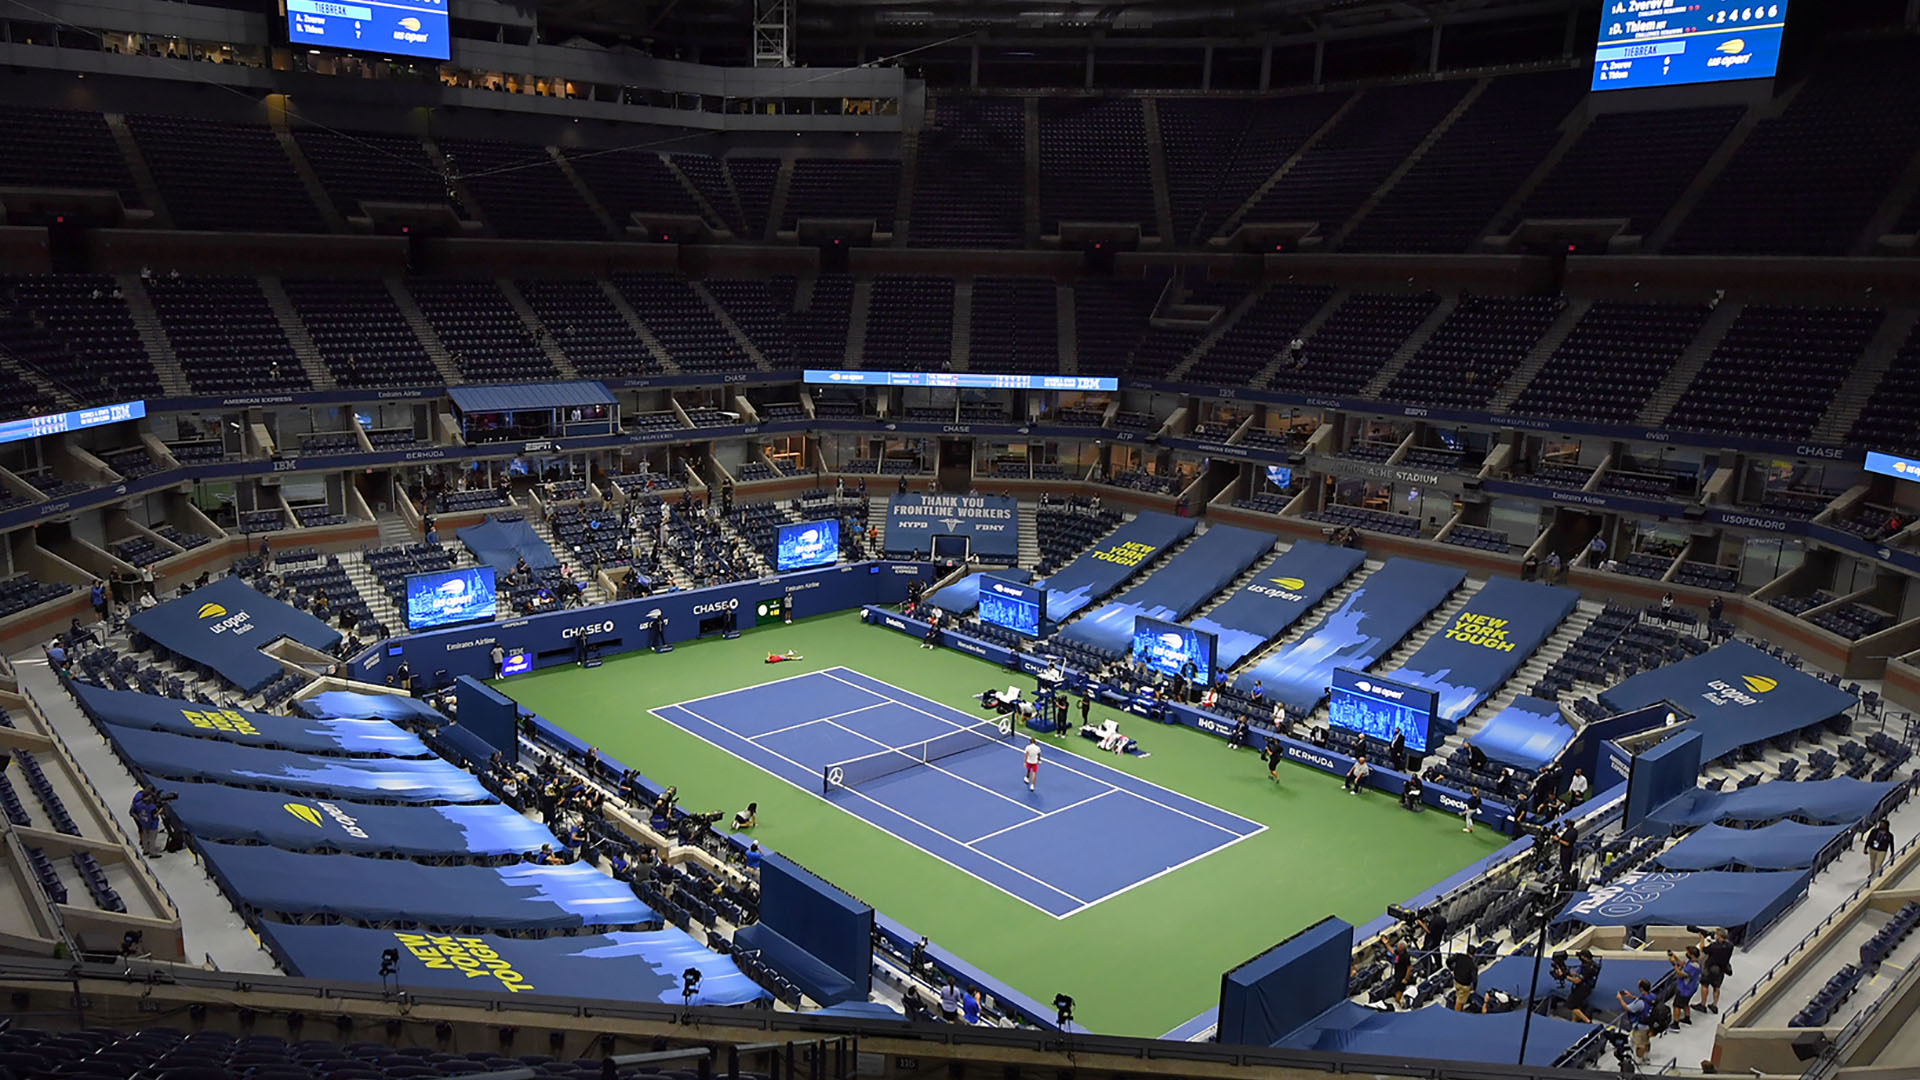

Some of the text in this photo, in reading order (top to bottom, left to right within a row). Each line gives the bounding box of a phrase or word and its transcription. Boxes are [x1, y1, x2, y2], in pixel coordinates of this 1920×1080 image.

[315, 2, 347, 15] TIEBREAK
[1626, 20, 1656, 33] Thiem
[1716, 10, 1726, 24] 2
[1729, 9, 1738, 21] 4
[1742, 8, 1751, 20] 6
[1755, 6, 1764, 19] 6
[1768, 4, 1777, 17] 6
[1624, 45, 1657, 57] TIEBREAK
[724, 374, 747, 383] CHASE
[223, 396, 293, 405] AMERICAN EXPRESS
[111, 404, 131, 421] IBM
[1404, 407, 1427, 417] ESPN
[943, 425, 970, 433] CHASE
[1645, 430, 1669, 441] evian
[1117, 432, 1133, 441] ATP
[525, 441, 551, 451] ESPN
[1796, 445, 1843, 459] CHASE
[406, 450, 444, 460] BERMUDA
[273, 459, 297, 471] IBM
[1396, 471, 1438, 485] STADIUM
[921, 495, 984, 508] THANK YOU
[1552, 491, 1606, 505] Emirates Airline
[893, 505, 1011, 519] FRONTLINE WORKERS
[898, 521, 1005, 532] NYPD FDNY
[1722, 513, 1786, 531] USOPEN.ORG
[1108, 546, 1148, 562] YORK
[1122, 541, 1156, 553] NEW
[1091, 550, 1142, 567] TOUGH
[1247, 584, 1303, 602] us open
[693, 600, 728, 615] CHASE
[209, 611, 251, 634] us open
[1459, 611, 1509, 629] NEW
[562, 624, 602, 639] CHASE
[1453, 621, 1509, 641] YORK
[446, 637, 496, 651] Emirates Airline
[1444, 628, 1515, 652] TOUGH
[1707, 680, 1757, 706] us open
[1198, 717, 1215, 730] IHG
[1288, 747, 1334, 769] BERMUDA
[393, 932, 455, 969] NEW
[425, 933, 490, 979] YORK
[454, 937, 535, 993] TOUGH
